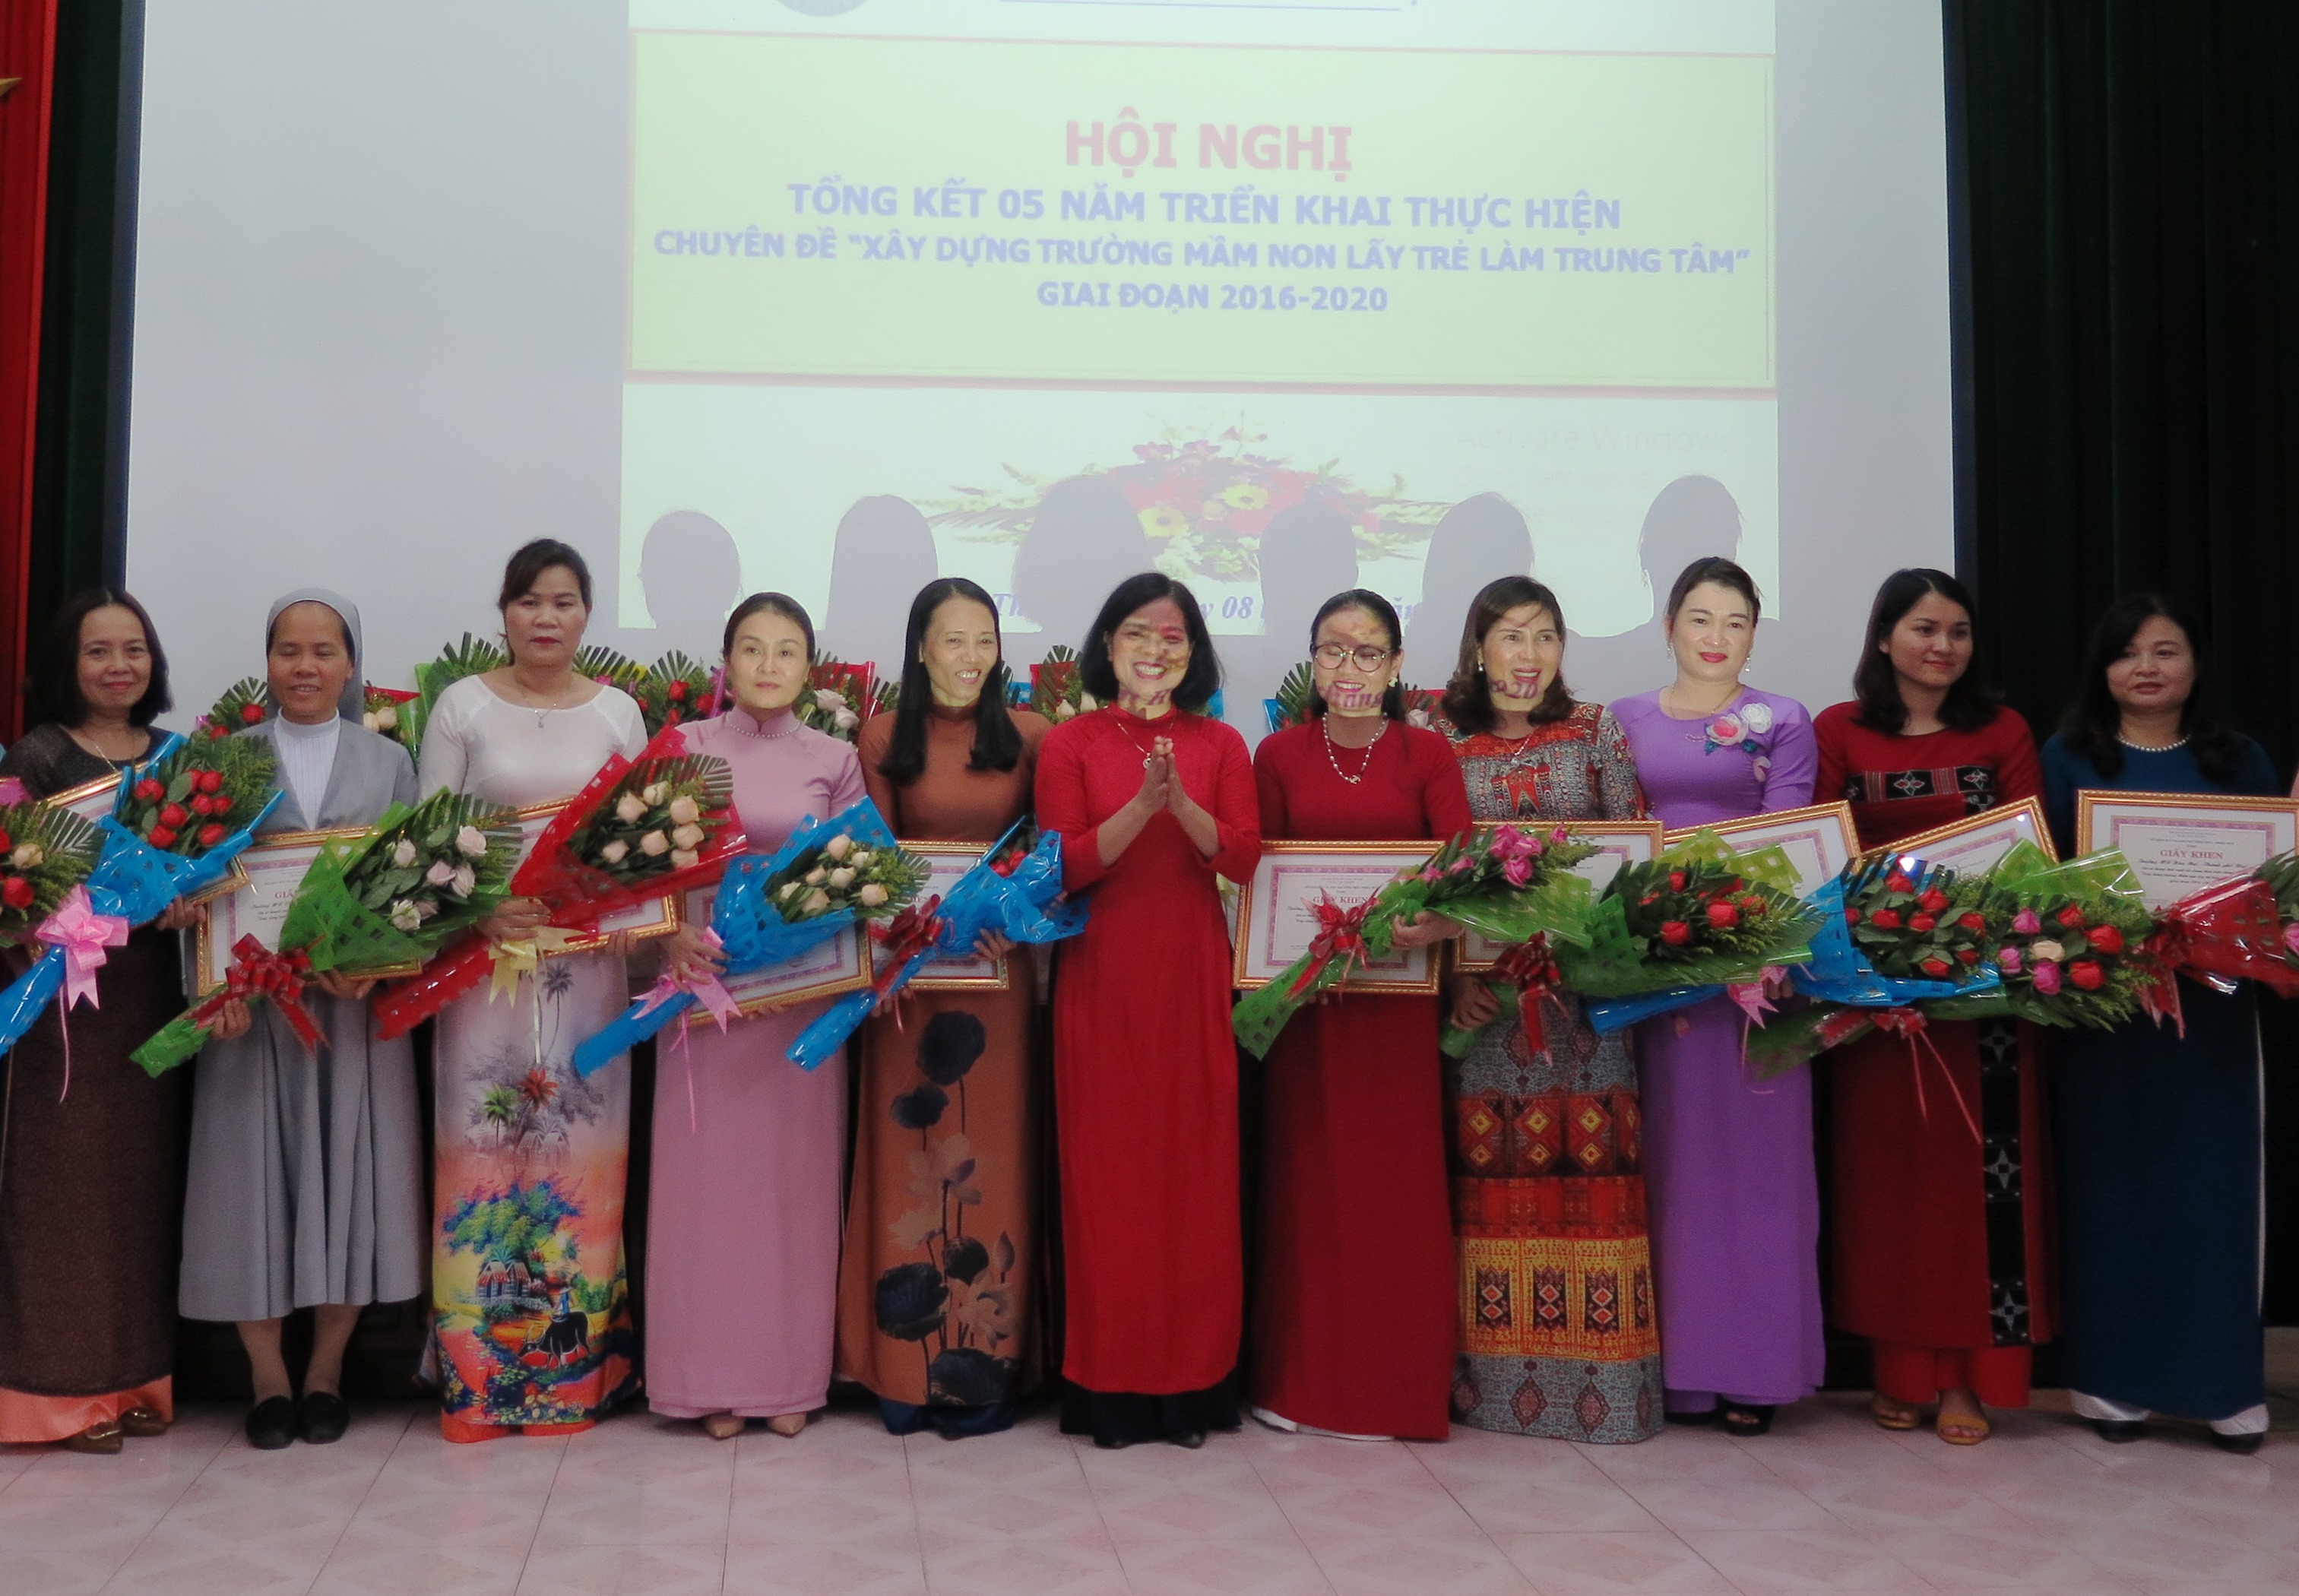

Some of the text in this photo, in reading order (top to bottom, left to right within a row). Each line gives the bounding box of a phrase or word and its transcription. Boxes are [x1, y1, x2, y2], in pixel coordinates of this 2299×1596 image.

[1066, 106, 1352, 182] HỘI NGHỊ
[787, 174, 1620, 236] TỔNG KẾT 05 NĂM TRIỂN KHAI THỰC HIỆN
[654, 224, 785, 258] CHUYÊN
[794, 226, 837, 258] ĐỀ
[936, 234, 1030, 268] DỰNG
[1036, 233, 1172, 266] TRƯỜNG
[1185, 234, 1257, 268] MẦM
[1268, 244, 1336, 268] NON
[1347, 238, 1405, 270] LẤY
[1411, 239, 1469, 271] TRẺ
[1480, 239, 1544, 271] LÀM
[1553, 247, 1661, 273] TRUNG
[1037, 280, 1388, 315] GIAI ĐOẠN 2016-2020
[1222, 596, 1253, 619] 08
[2159, 849, 2187, 857] GIẤY
